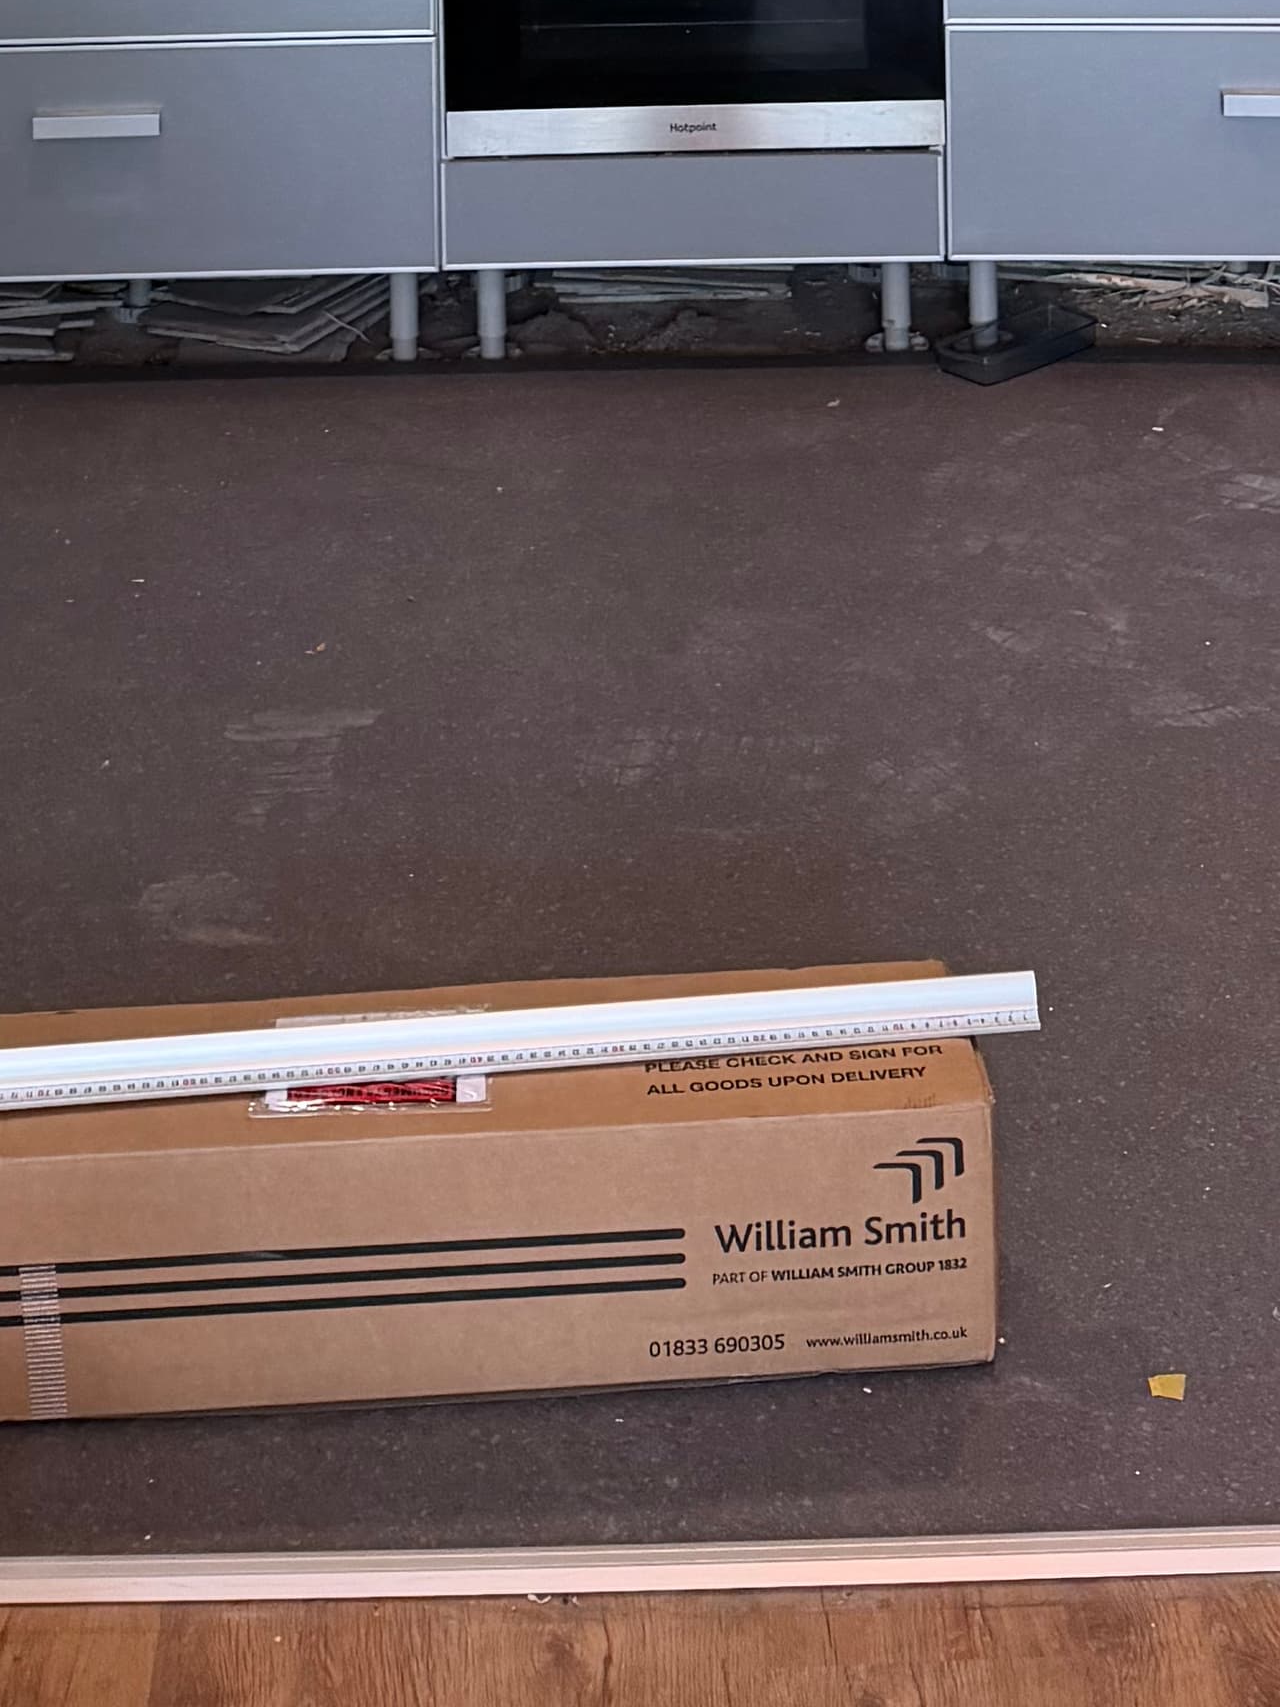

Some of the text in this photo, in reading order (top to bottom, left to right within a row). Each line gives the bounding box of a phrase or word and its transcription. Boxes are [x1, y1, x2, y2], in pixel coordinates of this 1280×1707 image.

[670, 122, 717, 133] Hotpoint
[645, 1044, 943, 1073] PLEASE CHECK AND SIGN FOR
[647, 1066, 926, 1095] ALL GOODS UPON DELIVERY
[714, 1209, 966, 1253] William Smith
[712, 1257, 967, 1285] PART OF WILLIAM SMITH GROUP 1832
[649, 1333, 785, 1358] 01833 690305
[806, 1327, 967, 1349] www.williamsmith.co.uk
